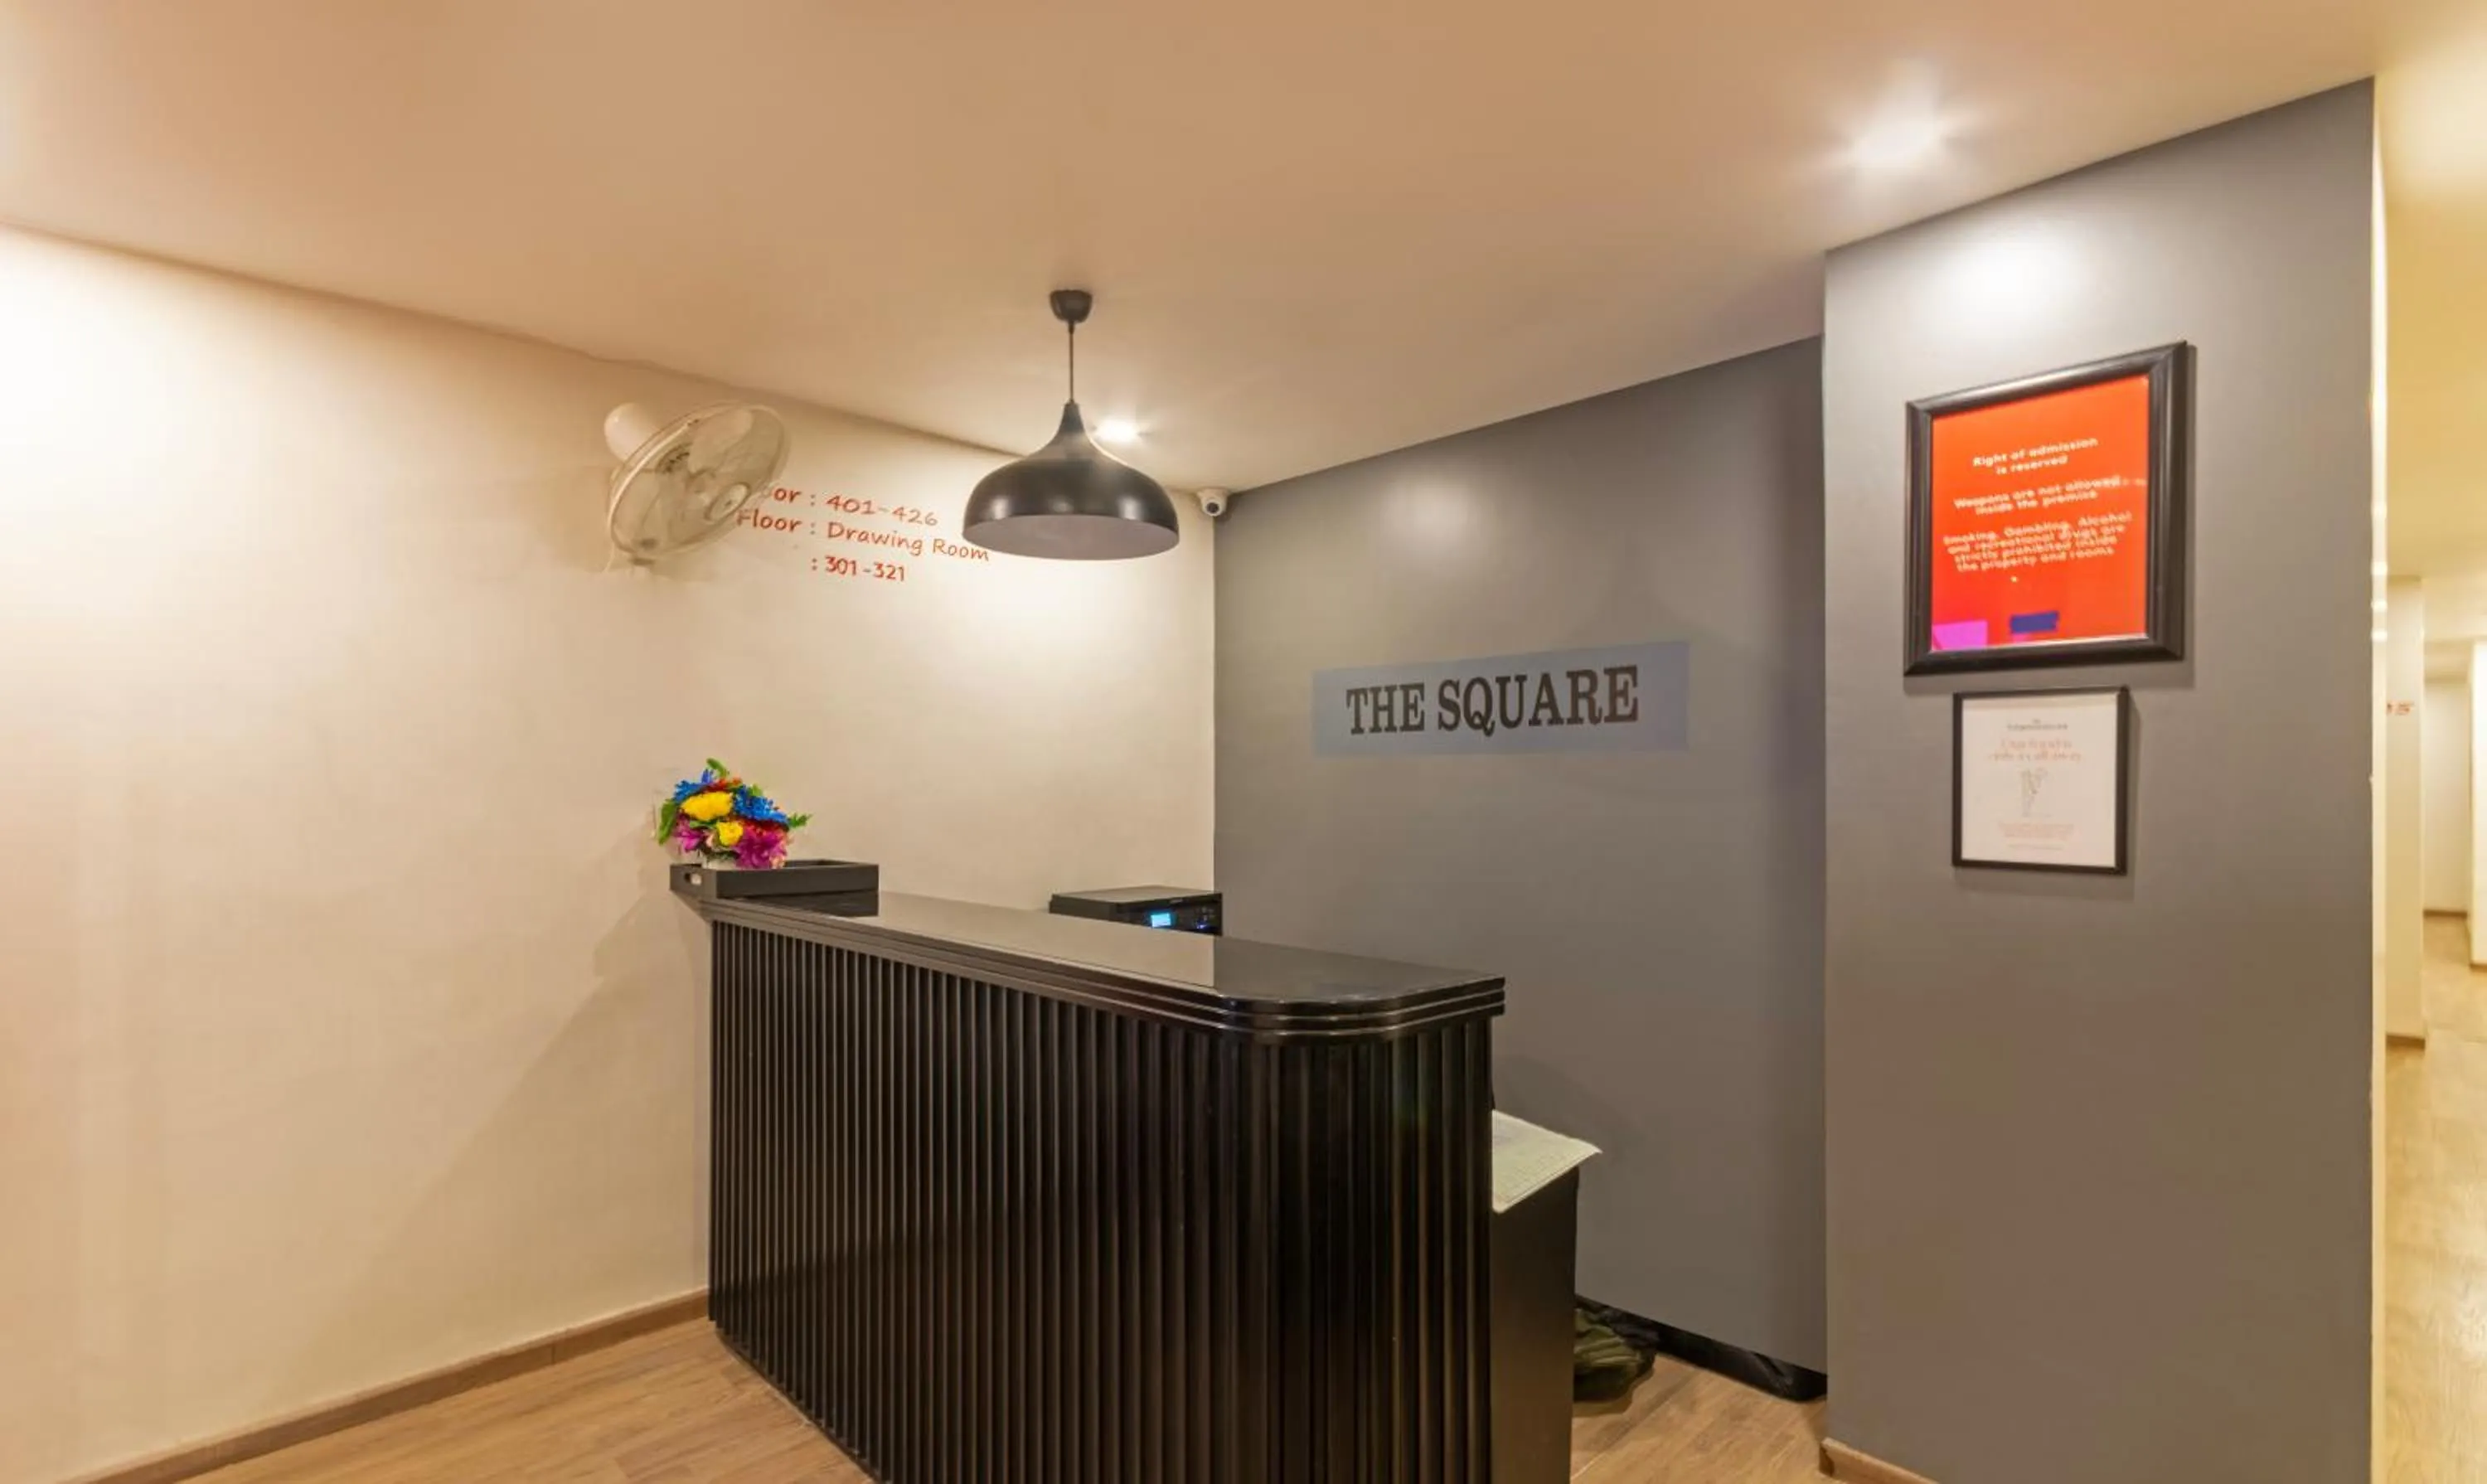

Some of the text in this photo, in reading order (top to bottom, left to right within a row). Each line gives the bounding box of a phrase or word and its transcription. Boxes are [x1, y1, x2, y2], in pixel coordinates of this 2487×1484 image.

[1972, 438, 2099, 468] Right of admission
[1996, 453, 2068, 475] is reserved
[1954, 493, 2010, 508] Weapons
[2038, 483, 2061, 495] not
[2016, 499, 2039, 509] the
[826, 495, 938, 526] 401-426
[736, 507, 802, 532] Floor
[827, 521, 924, 557] Drawing
[933, 537, 990, 562] Room
[825, 555, 906, 581] 301-321
[1345, 665, 1639, 737] THE SQUARE
